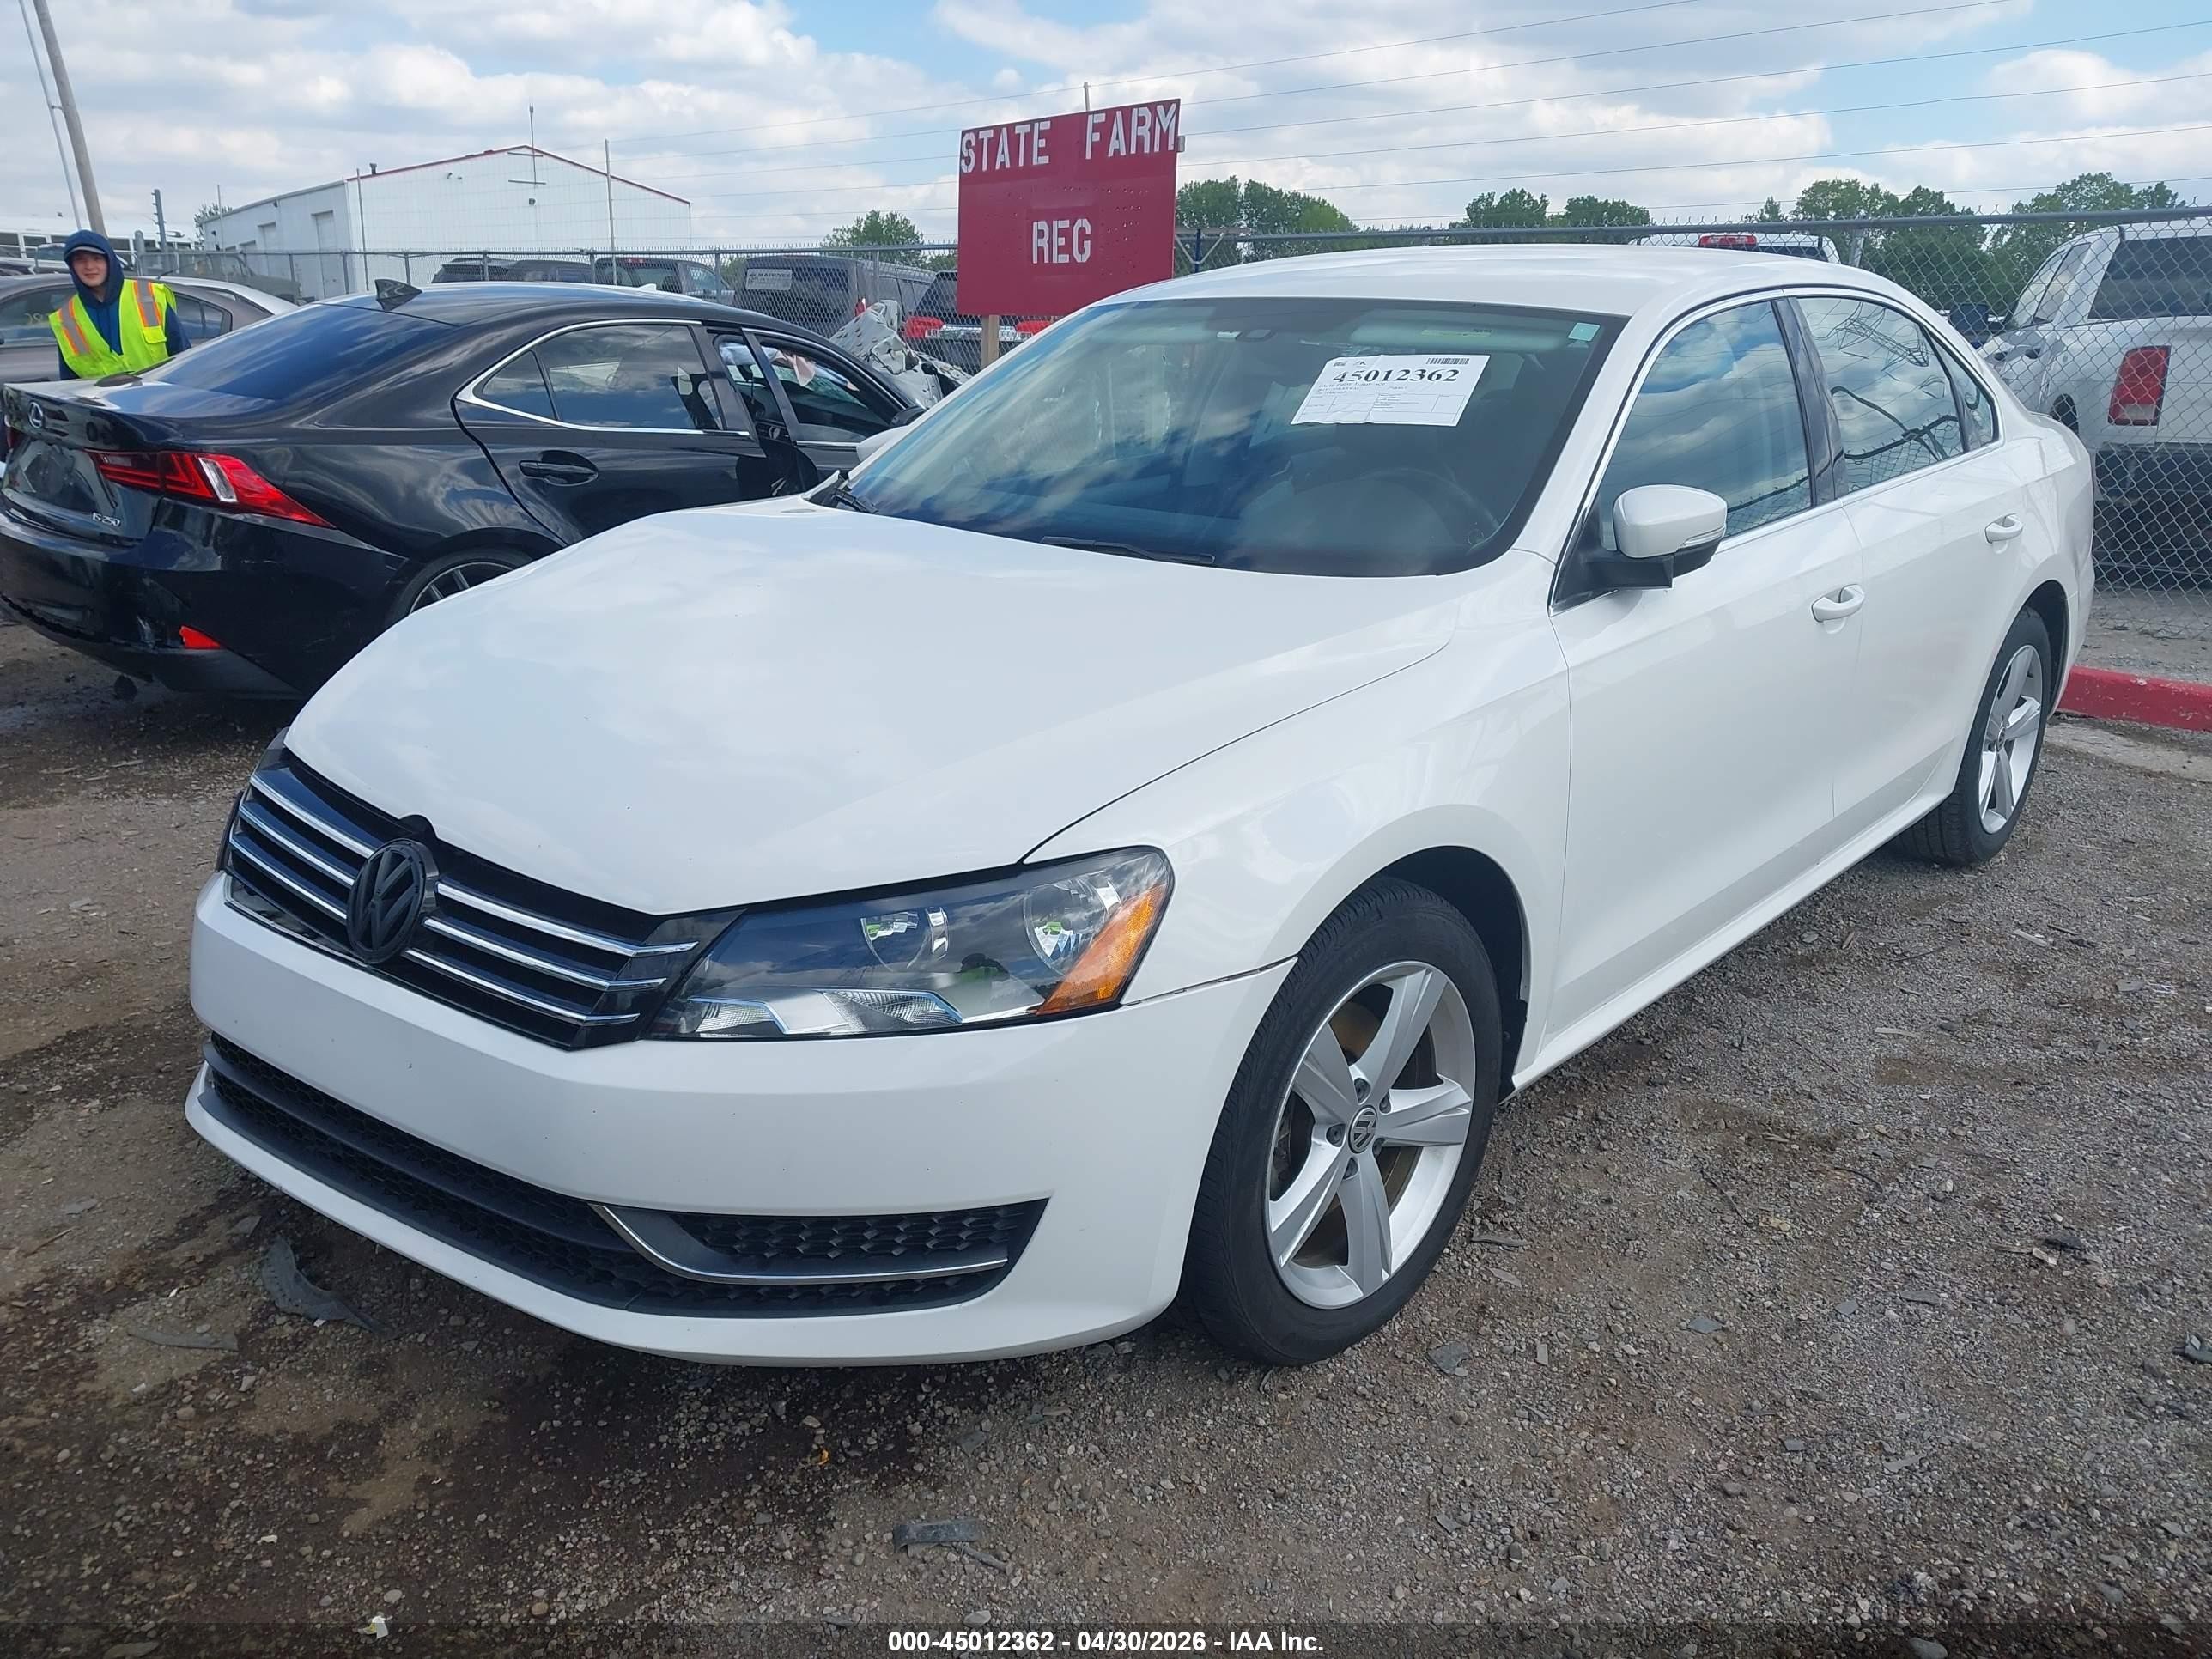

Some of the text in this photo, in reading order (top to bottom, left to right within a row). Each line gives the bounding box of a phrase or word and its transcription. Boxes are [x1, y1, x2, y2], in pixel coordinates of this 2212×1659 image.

[960, 102, 1177, 173] STATE FARM
[1032, 217, 1091, 264] REG
[1332, 368, 1460, 383] 45012362
[102, 515, 121, 526] 250
